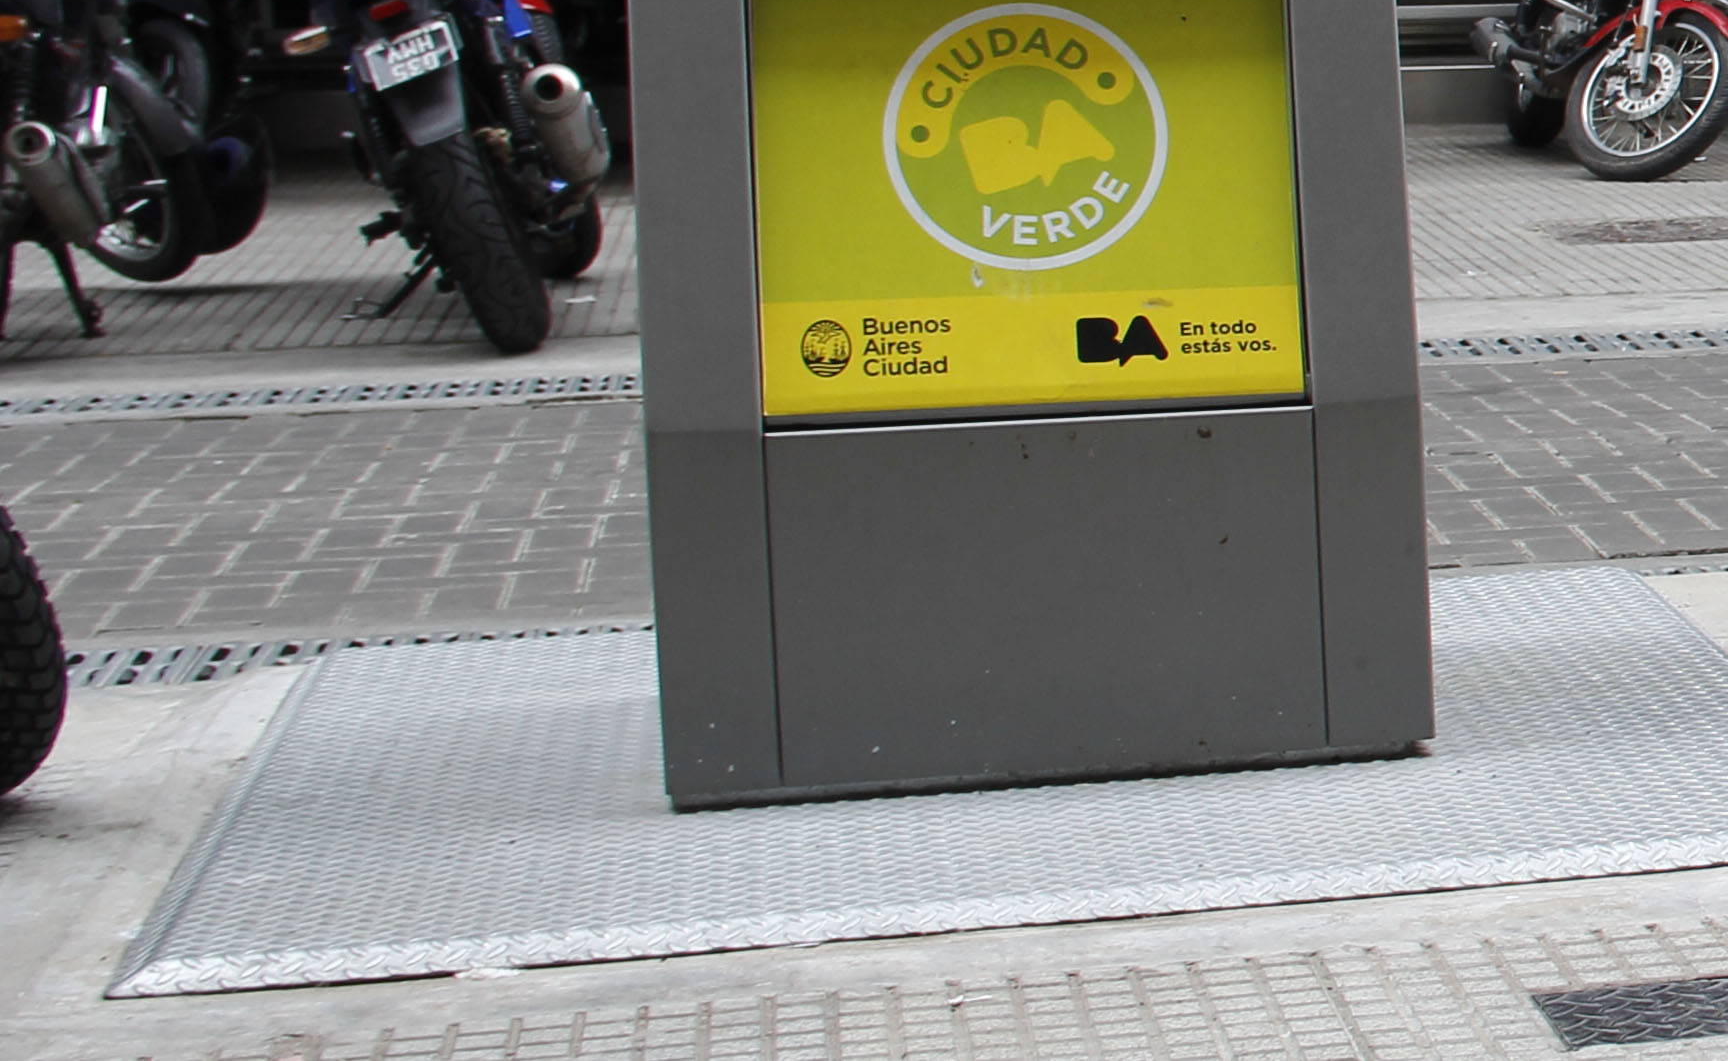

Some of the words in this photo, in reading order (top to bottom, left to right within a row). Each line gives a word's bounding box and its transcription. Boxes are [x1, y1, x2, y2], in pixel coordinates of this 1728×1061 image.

[921, 27, 1088, 111] CIUDAD
[981, 170, 1130, 246] VERDE
[862, 317, 951, 335] Buenos
[1180, 323, 1204, 335] En
[1211, 320, 1257, 334] todo
[863, 338, 922, 356] Aires
[1180, 338, 1231, 353] estás
[1236, 340, 1277, 352] vos.
[863, 356, 948, 376] Ciudad
